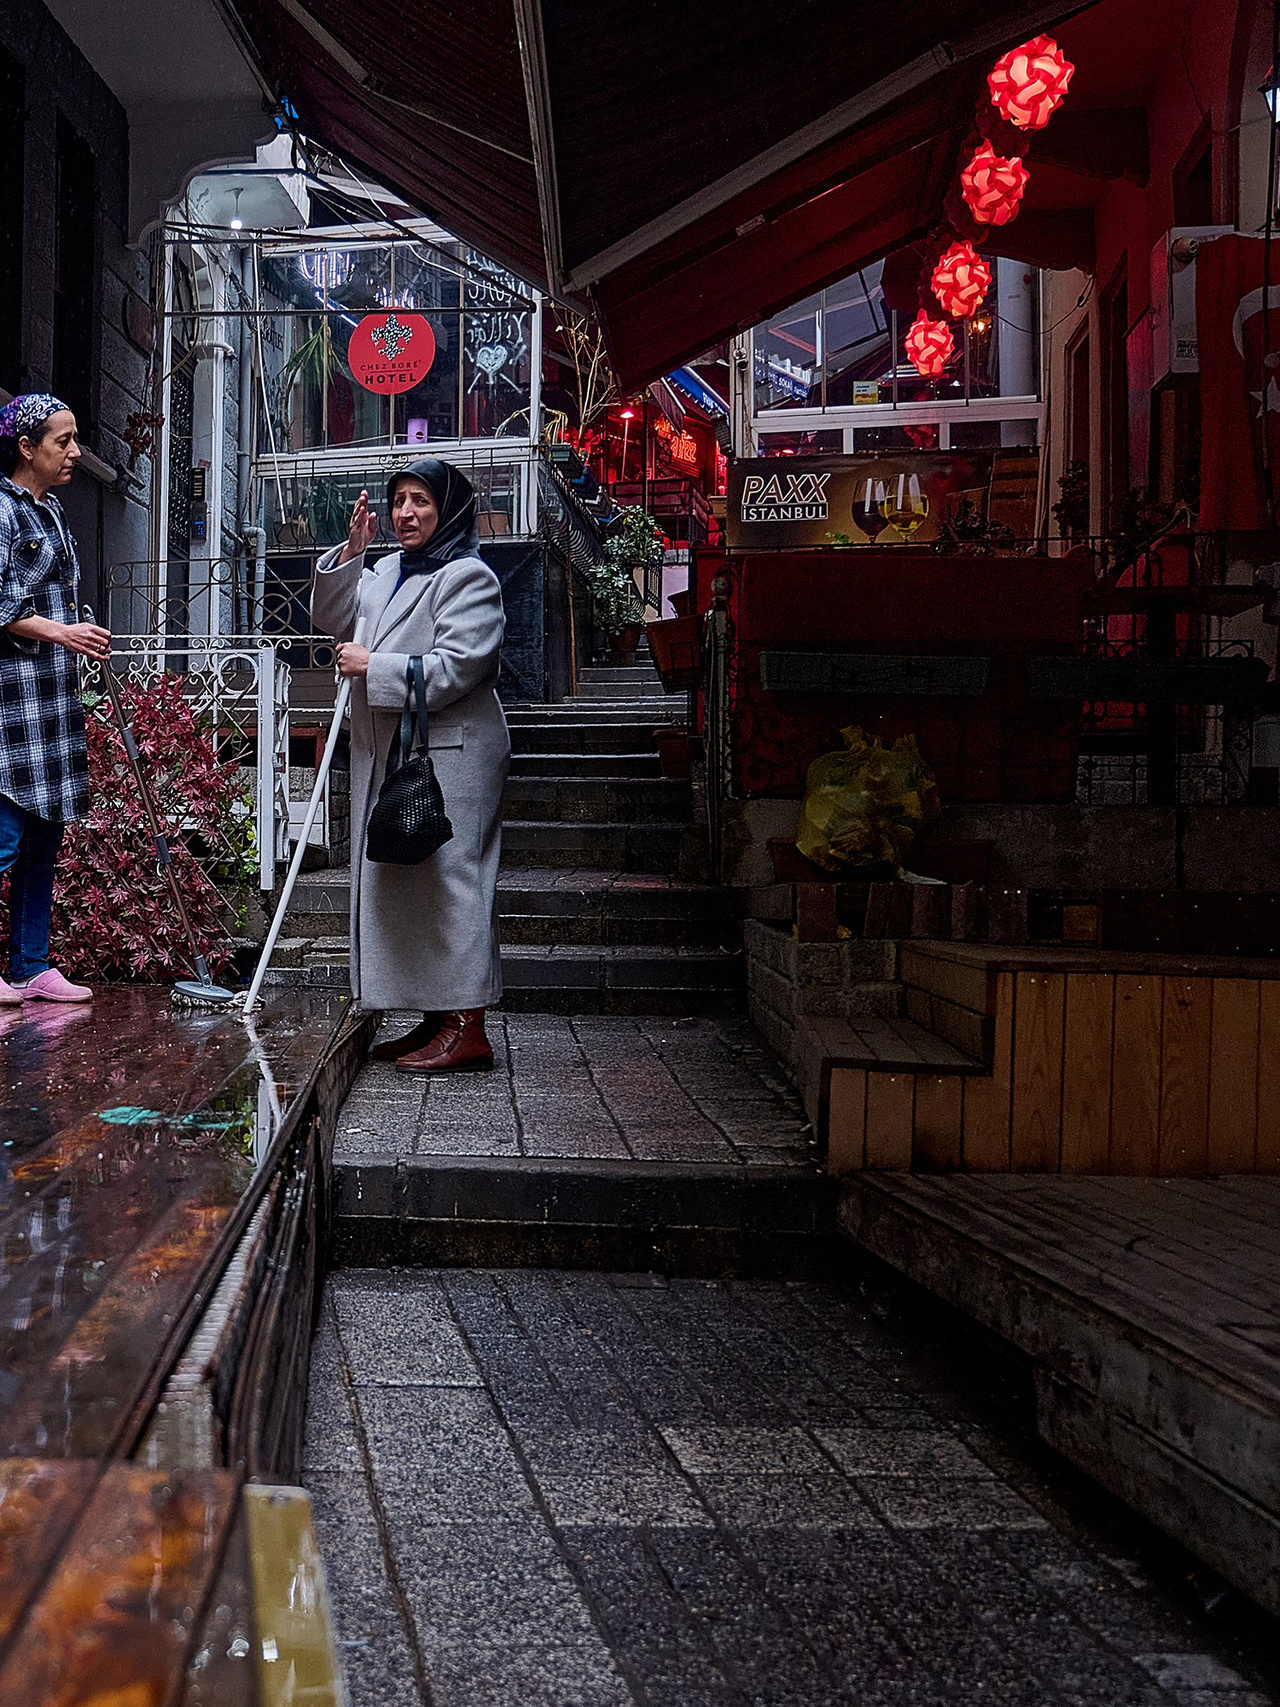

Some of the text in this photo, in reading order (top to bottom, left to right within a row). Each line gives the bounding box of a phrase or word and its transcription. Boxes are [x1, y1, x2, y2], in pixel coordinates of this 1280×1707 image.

[360, 363, 387, 371] CHEZ
[365, 373, 417, 384] HOTEL
[741, 473, 831, 504] PAXX
[743, 505, 826, 520] İSTANBUL
